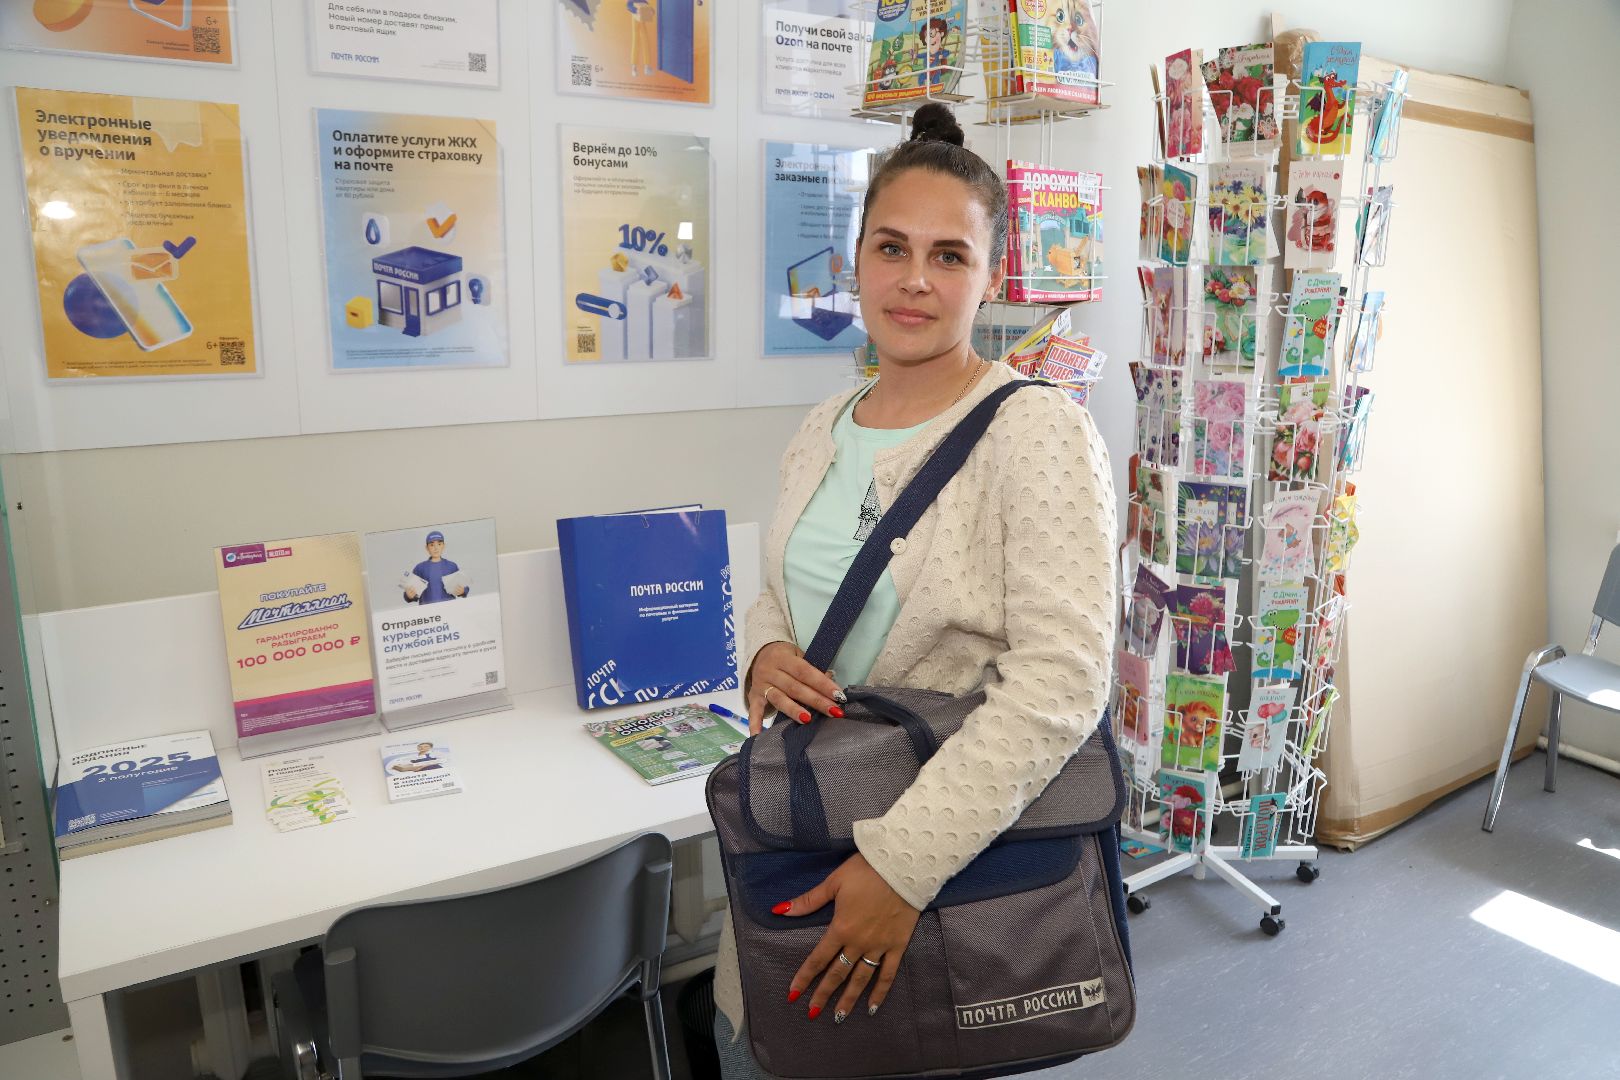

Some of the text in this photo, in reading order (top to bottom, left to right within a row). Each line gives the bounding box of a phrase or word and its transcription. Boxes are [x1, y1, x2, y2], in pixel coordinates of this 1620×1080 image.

[328, 3, 344, 11] Для
[346, 5, 365, 13] себя
[389, 10, 421, 20] подарок
[328, 12, 444, 32] Новый номер доставят прямо
[335, 24, 374, 34] почтовый
[776, 20, 818, 37] Получи
[820, 28, 846, 39] свой
[775, 34, 853, 53] Ozon на почте
[35, 109, 152, 130] Электронные
[37, 127, 152, 147] уведомления
[332, 129, 477, 149] Оплатите услуги ЖКХ
[39, 144, 136, 161] о вручении
[333, 145, 483, 165] и оформите страховку
[573, 142, 658, 158] Вернём до 10%
[334, 161, 394, 172] на почте
[573, 155, 628, 169] бонусами
[775, 172, 821, 184] заказные
[618, 223, 669, 257] 10%
[1048, 345, 1090, 371] ПЛАНЕТА
[1042, 361, 1075, 381] ЧУДЕС
[259, 583, 327, 603] ПОКУПАЙТЕ
[630, 579, 704, 597] ПОЧТА РОССИИ
[242, 593, 350, 627] Мечталлион
[381, 614, 442, 632] Отправьте
[255, 623, 340, 645] ГАРАНТИРОВАННО
[271, 632, 327, 649] РАЗЫГРАЕМ
[382, 622, 450, 645] курьерской
[383, 631, 461, 654] службой EMS
[236, 654, 267, 669] 100
[272, 646, 307, 662] 000
[312, 639, 345, 654] 000
[71, 750, 131, 766] ИЗДАНИЯ
[81, 751, 192, 781] 2025
[109, 765, 179, 784] полугодие
[962, 988, 1078, 1025] ПОЧТА РОССИИ
